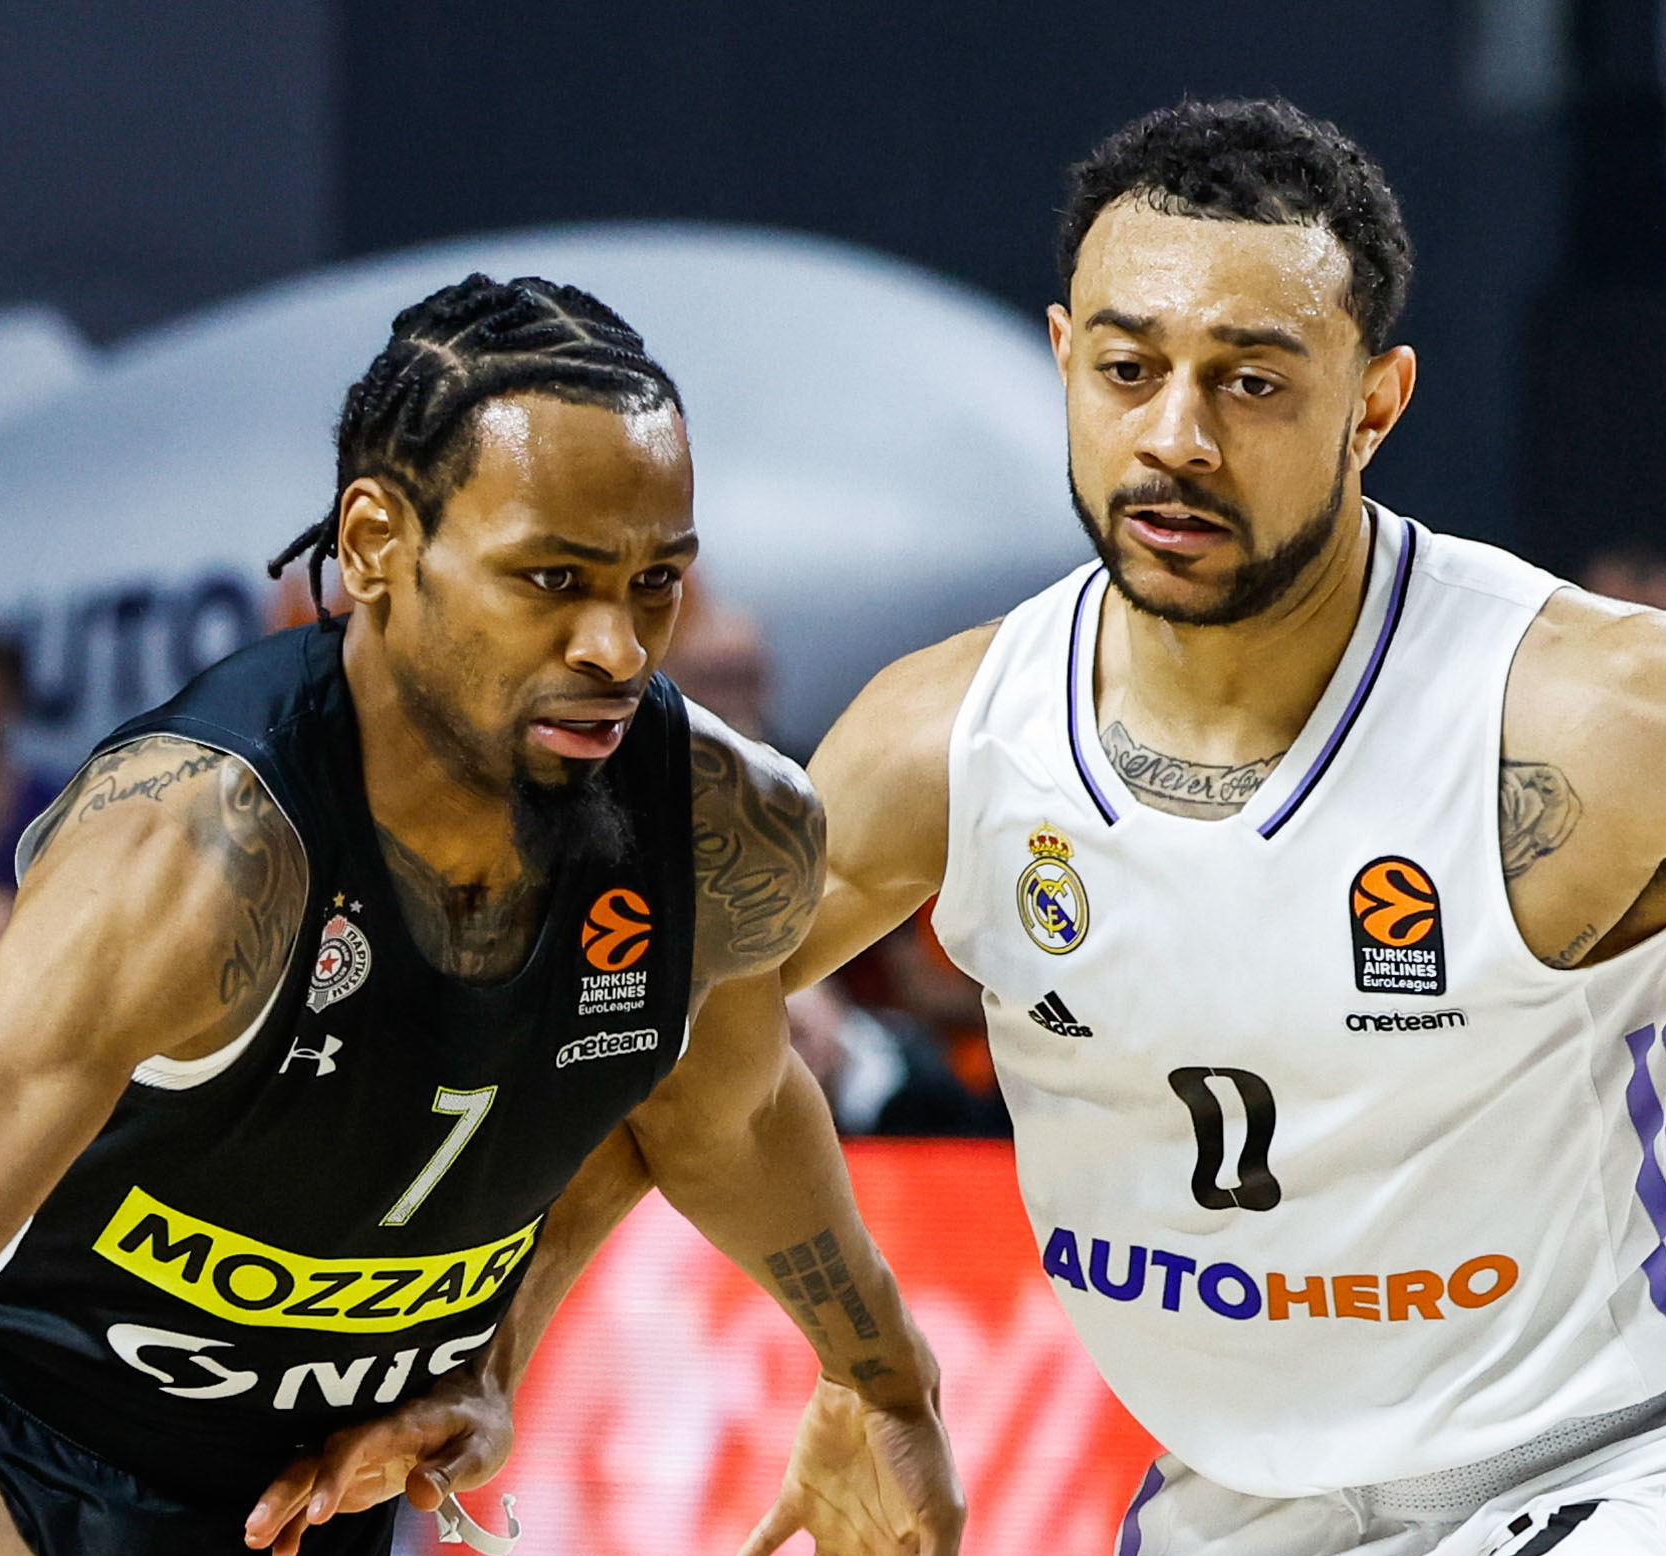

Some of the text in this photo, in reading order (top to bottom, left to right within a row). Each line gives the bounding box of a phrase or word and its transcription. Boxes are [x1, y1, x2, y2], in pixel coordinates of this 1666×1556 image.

[1362, 948, 1436, 963] TURKISH
[1363, 962, 1437, 977] AIRLINES
[581, 971, 647, 990] TURKISH
[1363, 975, 1438, 992] EuroLeague
[579, 985, 646, 1003] AIRLINES
[578, 999, 645, 1015] EuroLeague
[1346, 1012, 1465, 1031] oneteam
[556, 1029, 659, 1068] oneteam
[1167, 1065, 1282, 1212] 0
[379, 1085, 499, 1227] 7
[117, 1212, 530, 1319] MOZZAR
[1041, 1226, 1519, 1322] AUTOHERO
